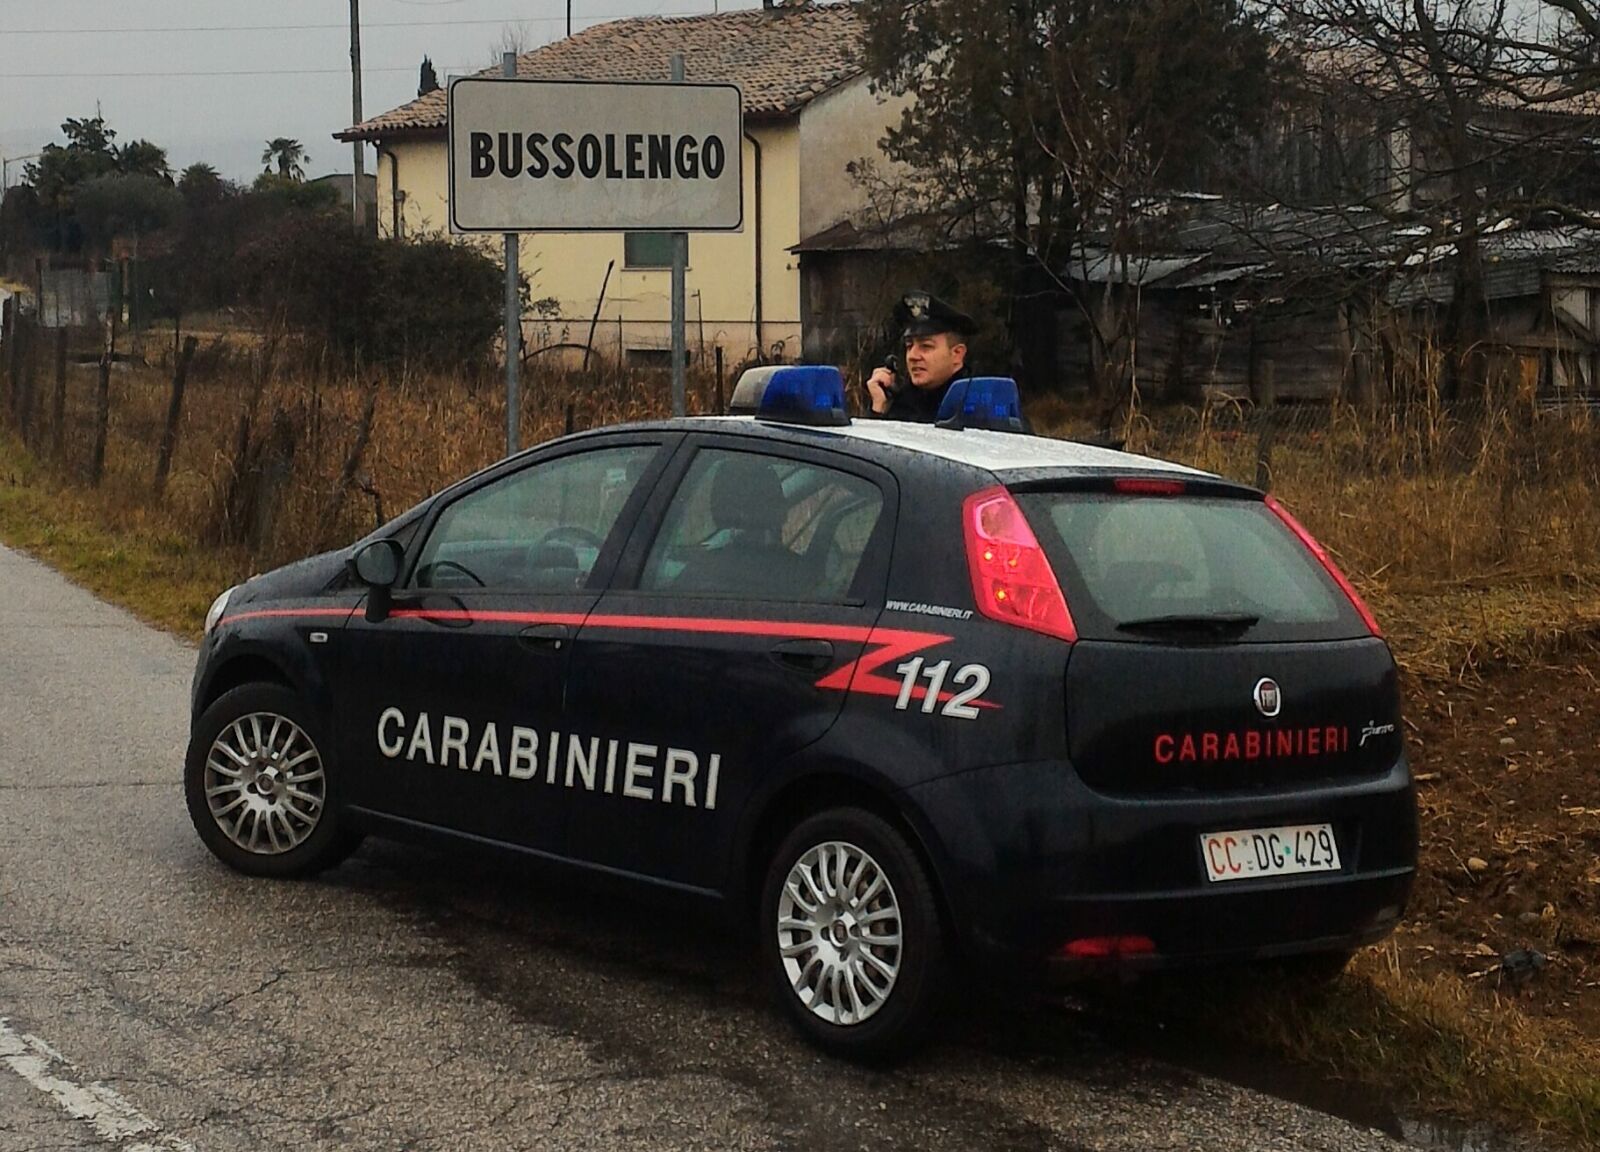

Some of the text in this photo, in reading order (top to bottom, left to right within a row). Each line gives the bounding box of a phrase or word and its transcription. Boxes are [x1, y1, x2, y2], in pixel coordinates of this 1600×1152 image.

[470, 132, 725, 179] BUSSOLENGO
[895, 657, 991, 720] 112
[377, 706, 721, 810] CARABINIERI
[1154, 726, 1348, 763] CARABINIERI
[1208, 830, 1334, 874] CC DG 429
